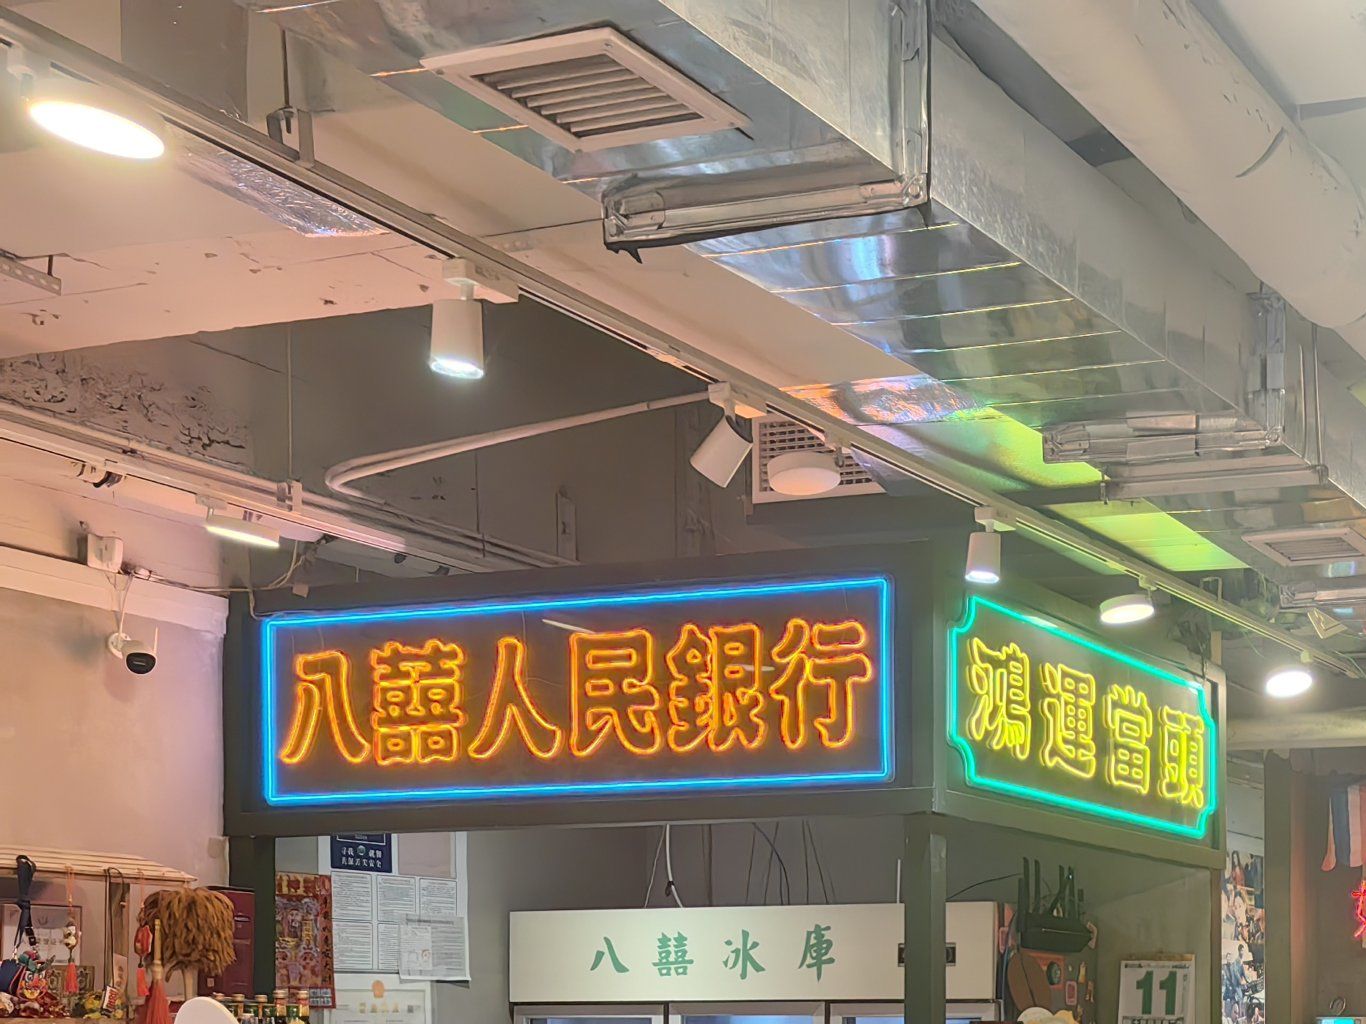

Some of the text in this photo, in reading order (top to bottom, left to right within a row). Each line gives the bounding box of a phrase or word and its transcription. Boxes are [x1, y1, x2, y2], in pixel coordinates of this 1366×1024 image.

[280, 616, 876, 770] 八囍人民銀行
[963, 633, 1207, 810] 鴻運當頭
[590, 924, 838, 982] 八囍冰庫
[1135, 970, 1178, 1016] 11
